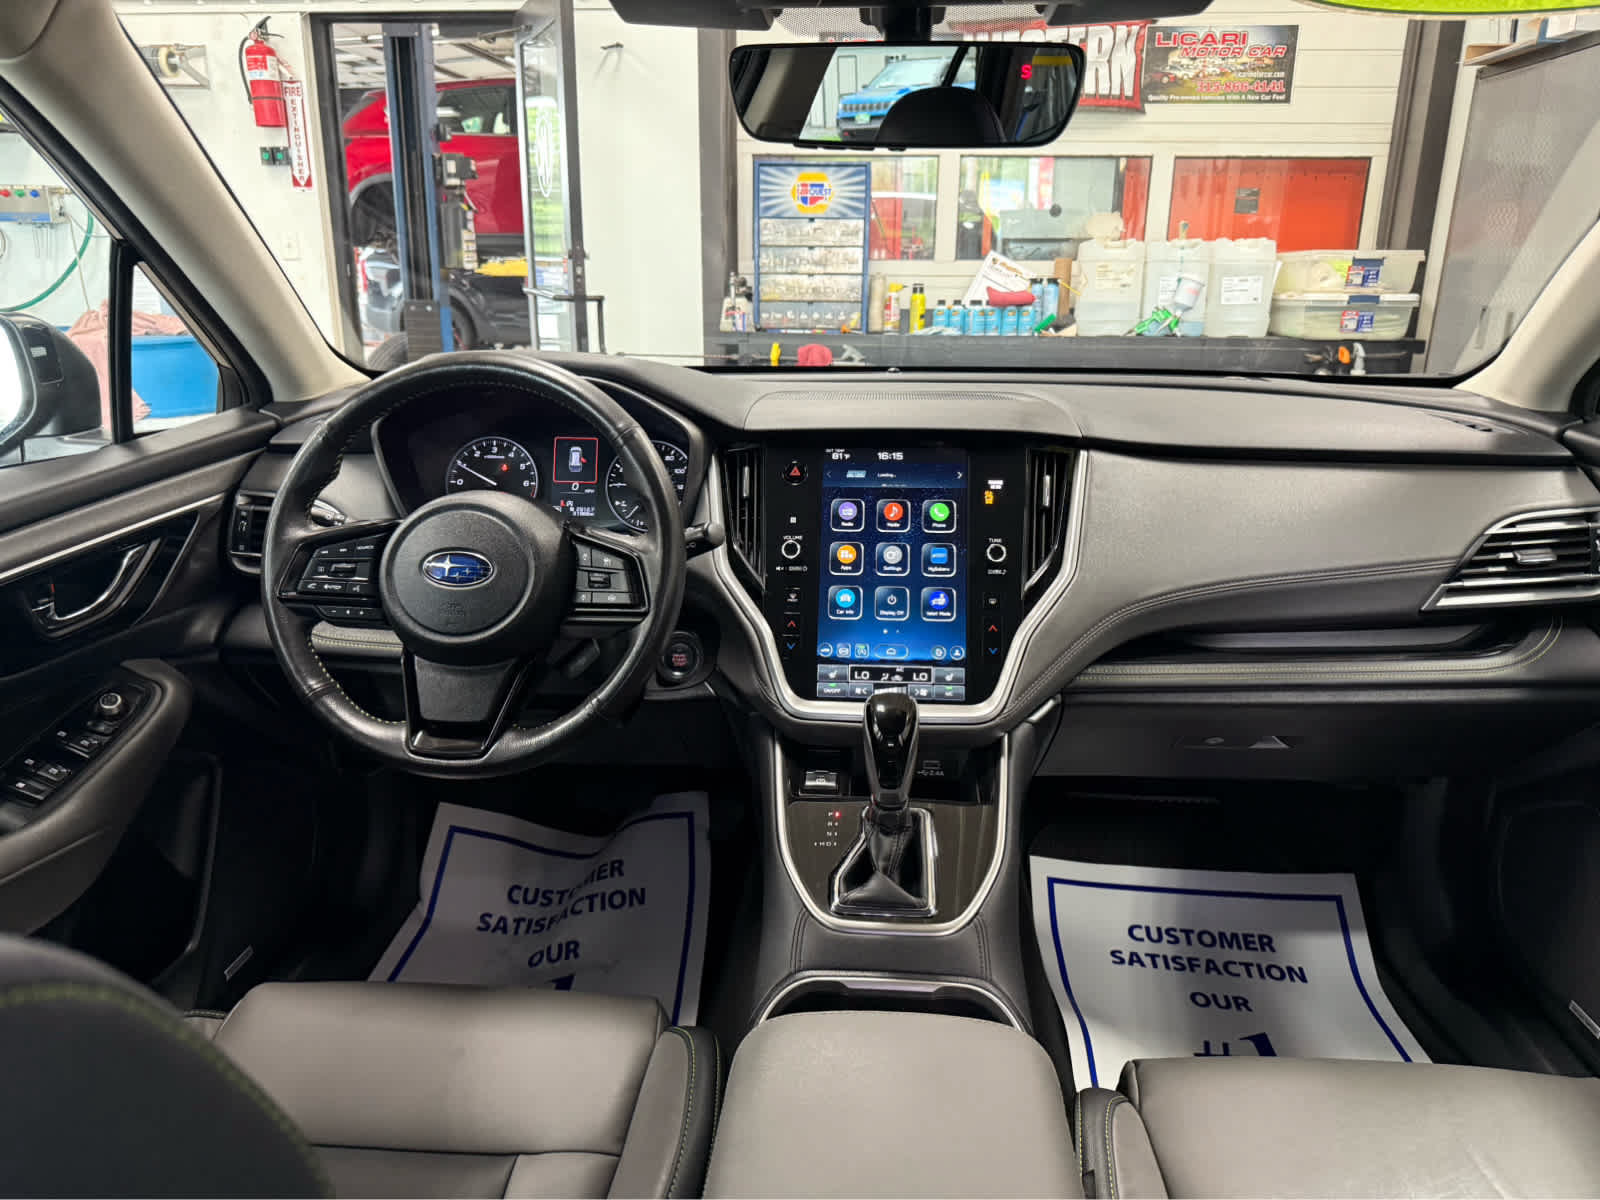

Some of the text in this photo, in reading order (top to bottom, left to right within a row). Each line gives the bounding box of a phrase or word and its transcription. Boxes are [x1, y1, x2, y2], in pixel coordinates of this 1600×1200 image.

[1156, 32, 1247, 46] LICARI
[1181, 46, 1287, 57] MOTOR CAR
[1021, 64, 1032, 80] S
[284, 86, 301, 97] FIRE
[290, 99, 305, 182] EXTINGUISHER
[877, 452, 904, 460] 16:15
[571, 482, 580, 491] 0
[854, 671, 929, 681] LO LO
[507, 859, 626, 907] CUSTER
[476, 887, 647, 936] SATISFACTION
[1127, 924, 1277, 952] CUSTOMER
[528, 940, 581, 969] OUR
[1110, 950, 1309, 983] SATISFACTION
[1190, 991, 1254, 1012] OUR
